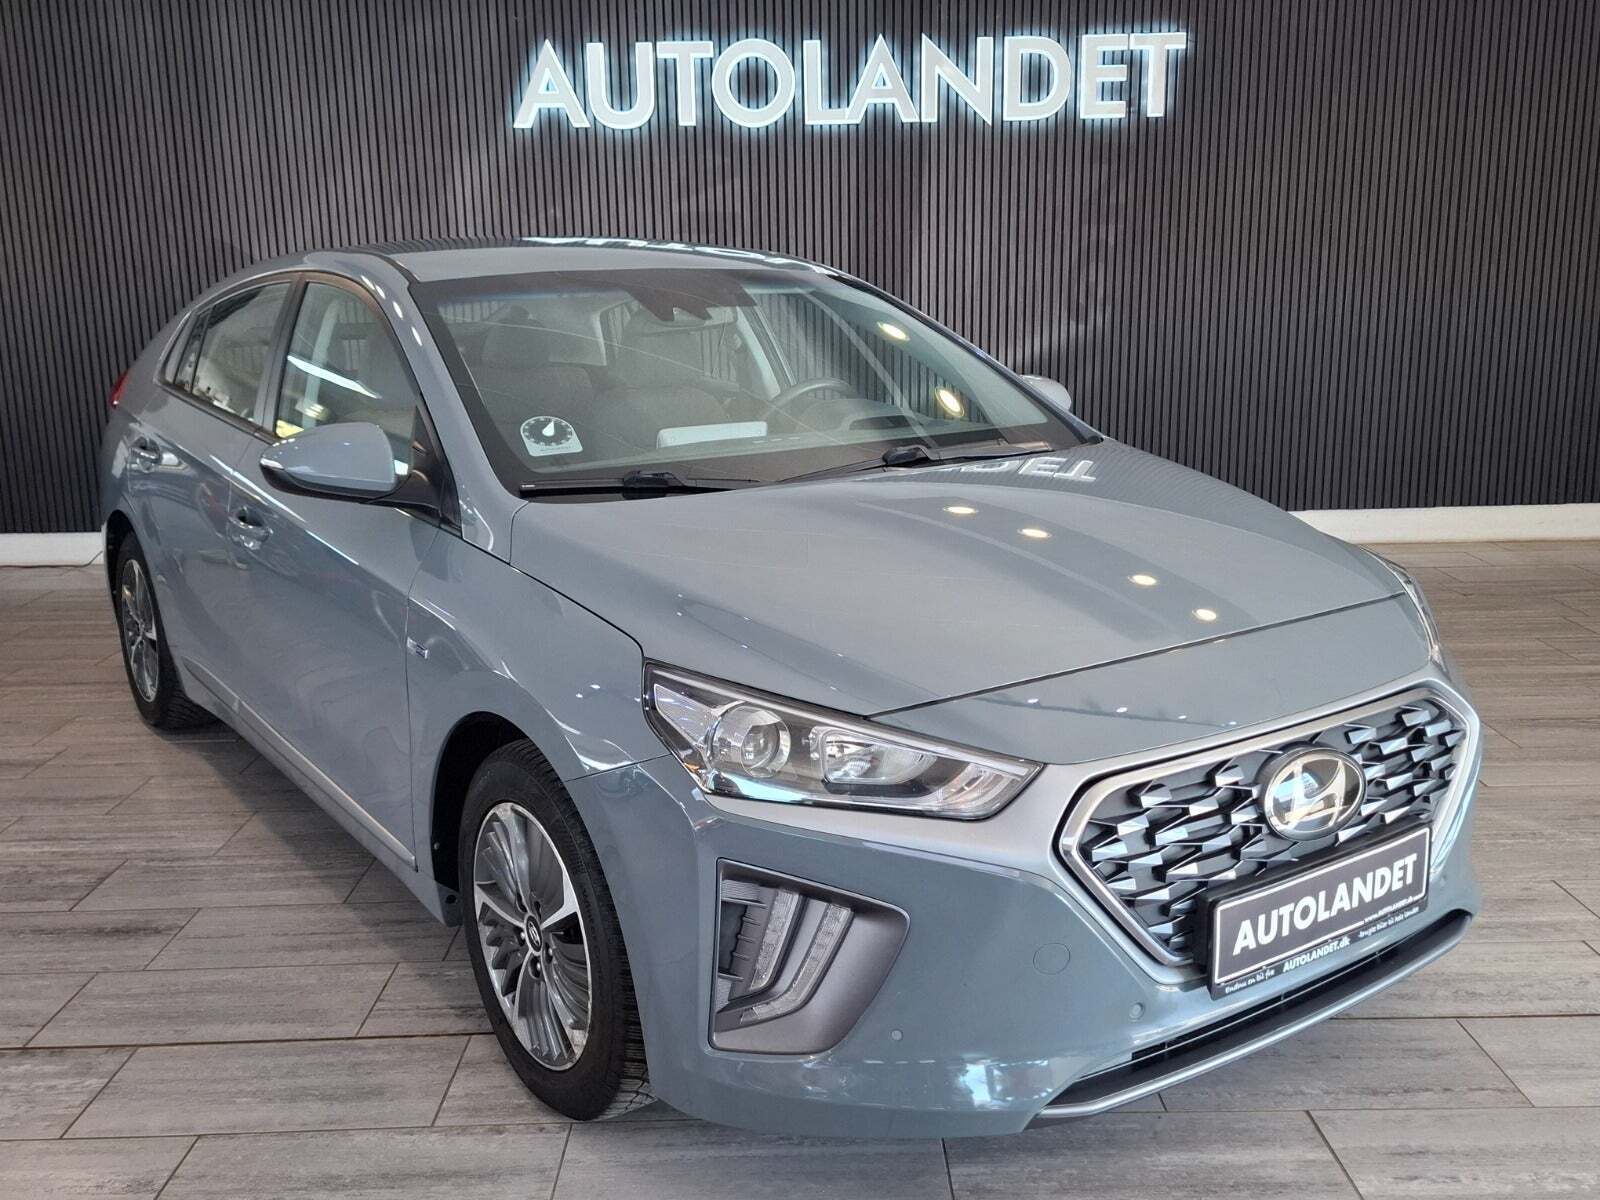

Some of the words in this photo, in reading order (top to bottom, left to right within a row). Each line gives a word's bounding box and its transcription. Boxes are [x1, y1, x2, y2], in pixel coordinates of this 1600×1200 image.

[513, 33, 1186, 129] AUTOLANDET
[1232, 853, 1418, 956] AUTOLANDET
[1282, 936, 1351, 973] AUTOLANDET.dk
